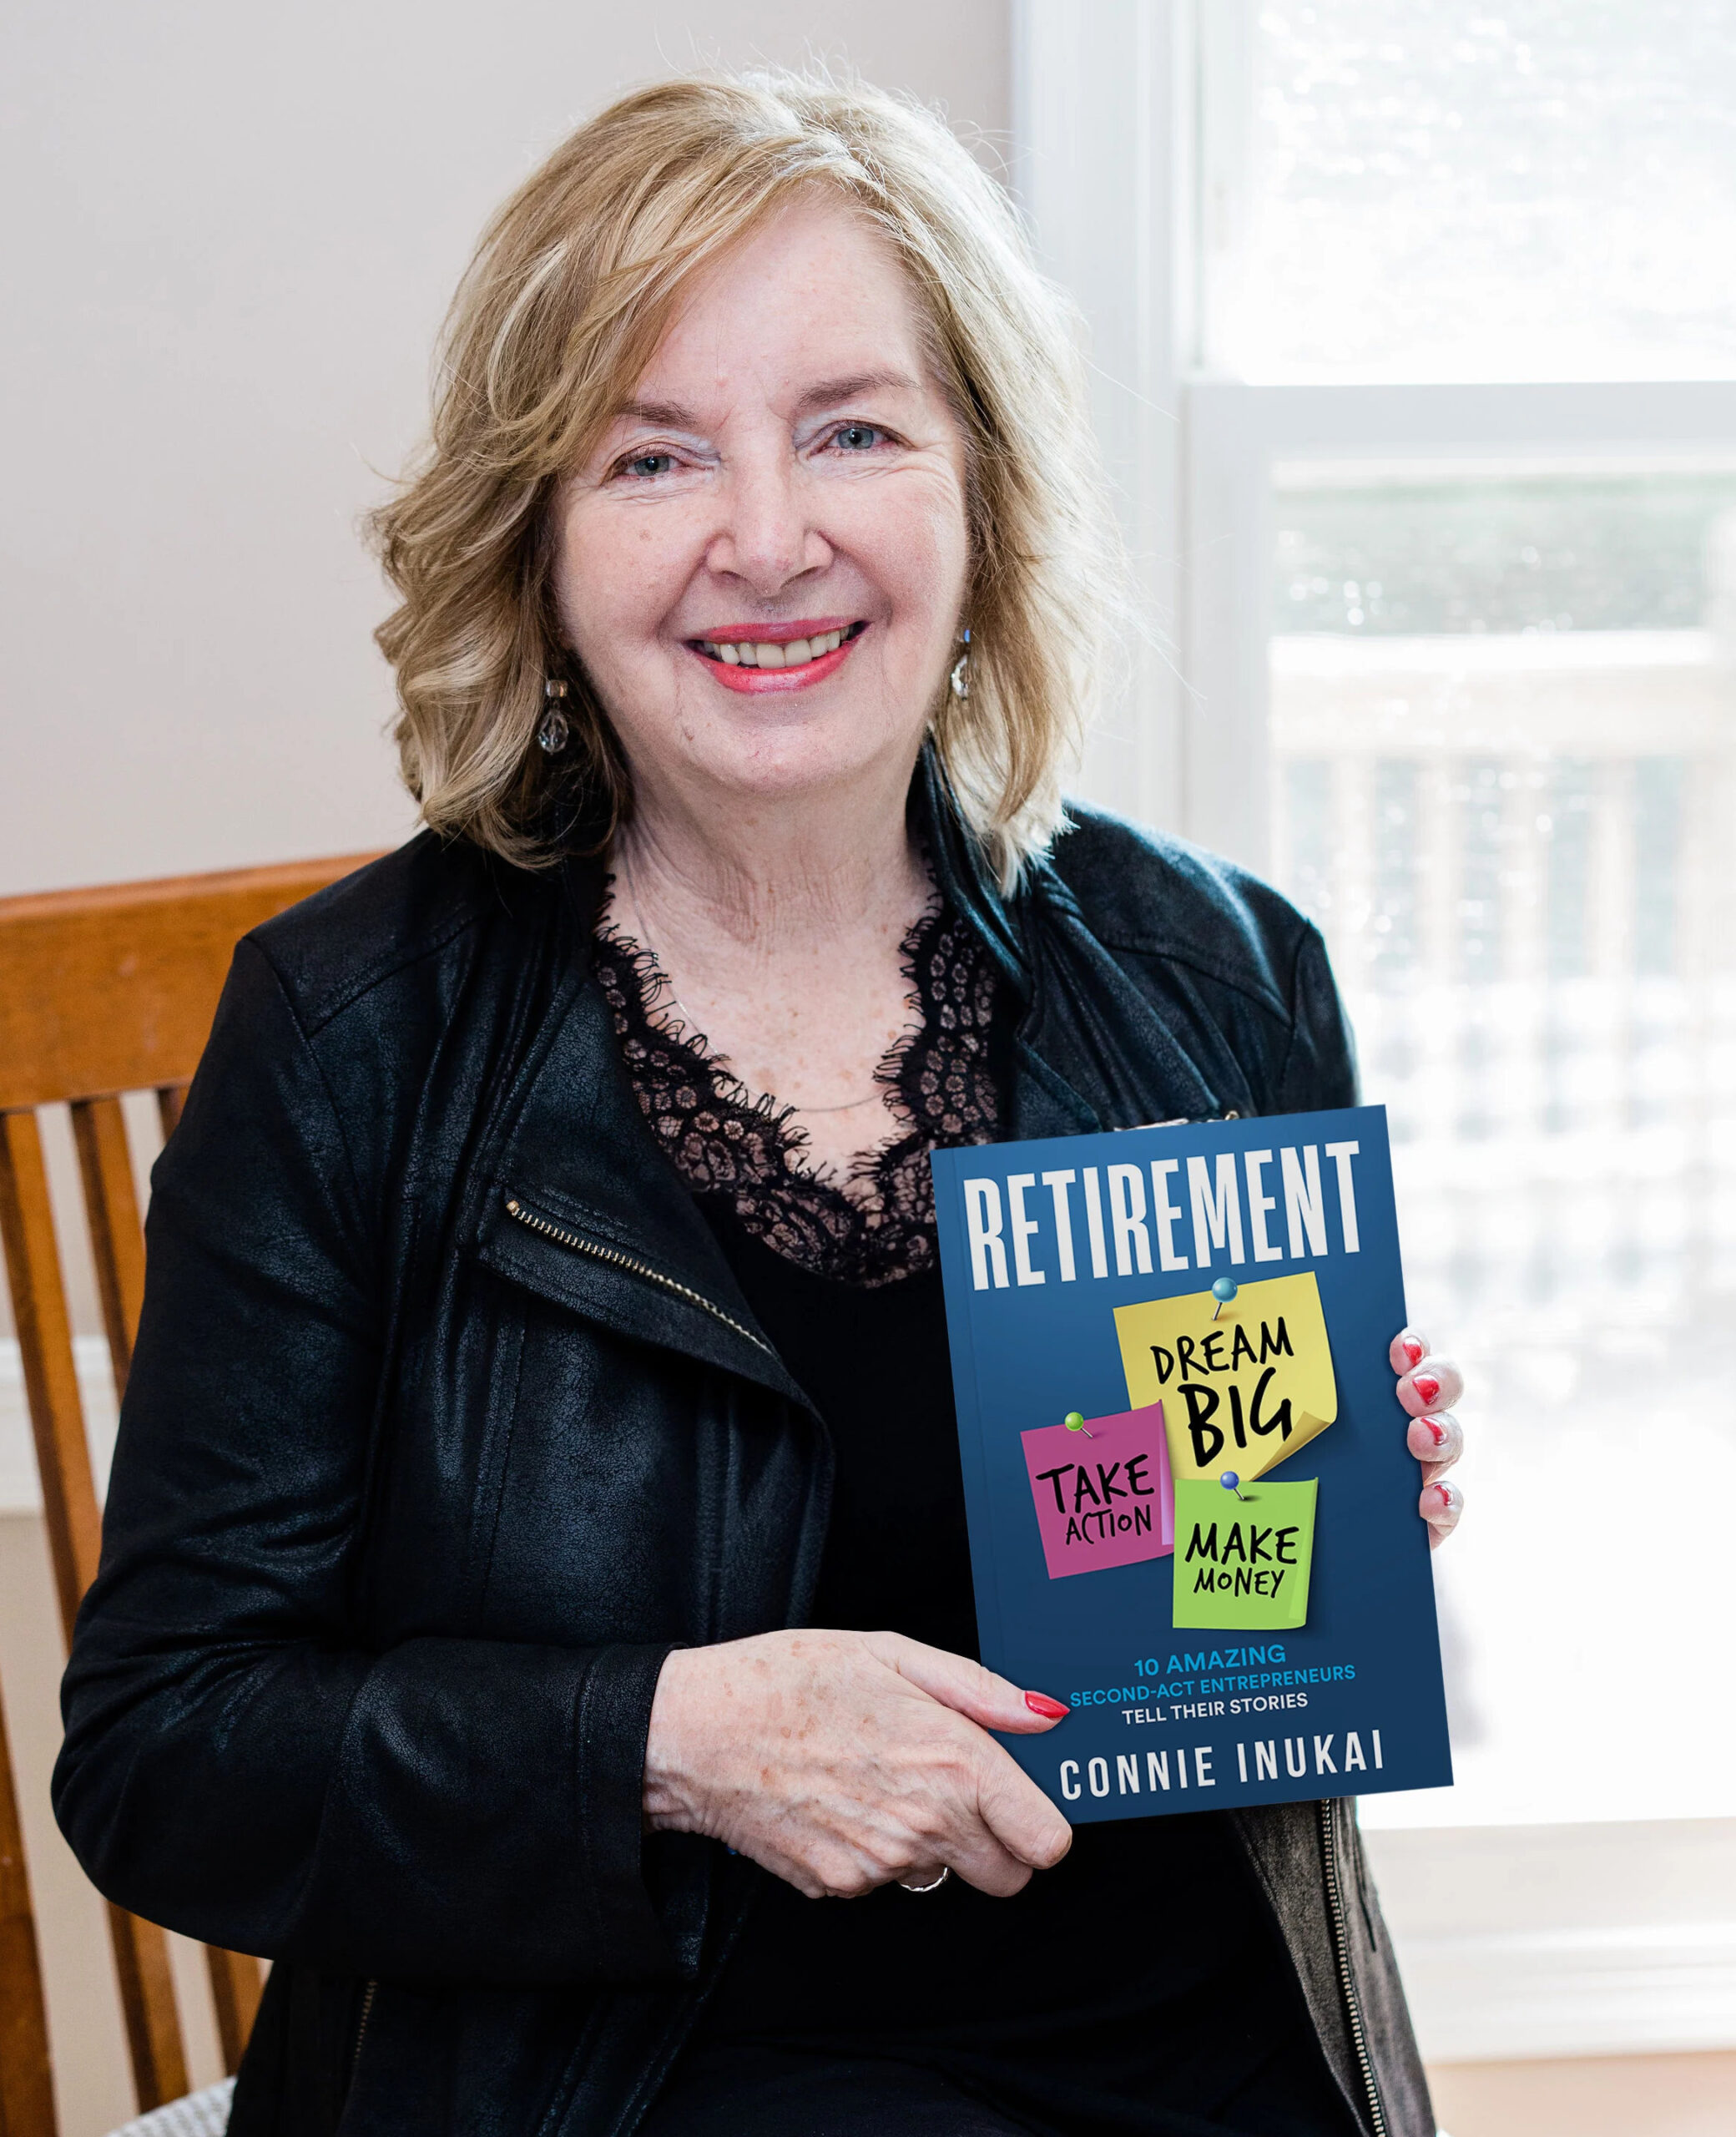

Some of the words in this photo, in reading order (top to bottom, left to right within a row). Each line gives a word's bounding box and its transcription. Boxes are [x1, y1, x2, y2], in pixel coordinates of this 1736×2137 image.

[963, 1140, 1360, 1291] RETIREMENT
[1149, 1316, 1294, 1385] DREAM
[1177, 1367, 1293, 1468] BIG
[1036, 1453, 1155, 1514] TAKE
[1065, 1504, 1152, 1545] ACTION
[1184, 1522, 1299, 1565] MAKE
[1193, 1567, 1285, 1599] MONEY
[1134, 1658, 1159, 1677] 10
[1167, 1644, 1286, 1674] AMAZING
[1070, 1680, 1195, 1707] SECOND-ACT
[1200, 1664, 1356, 1695] ENTREPRENEURS
[1122, 1706, 1167, 1725] TELL
[1170, 1701, 1225, 1720] THEIR
[1229, 1692, 1309, 1714] STORIES
[1059, 1745, 1216, 1801] CONNIE
[1236, 1729, 1384, 1783] INUKAI
